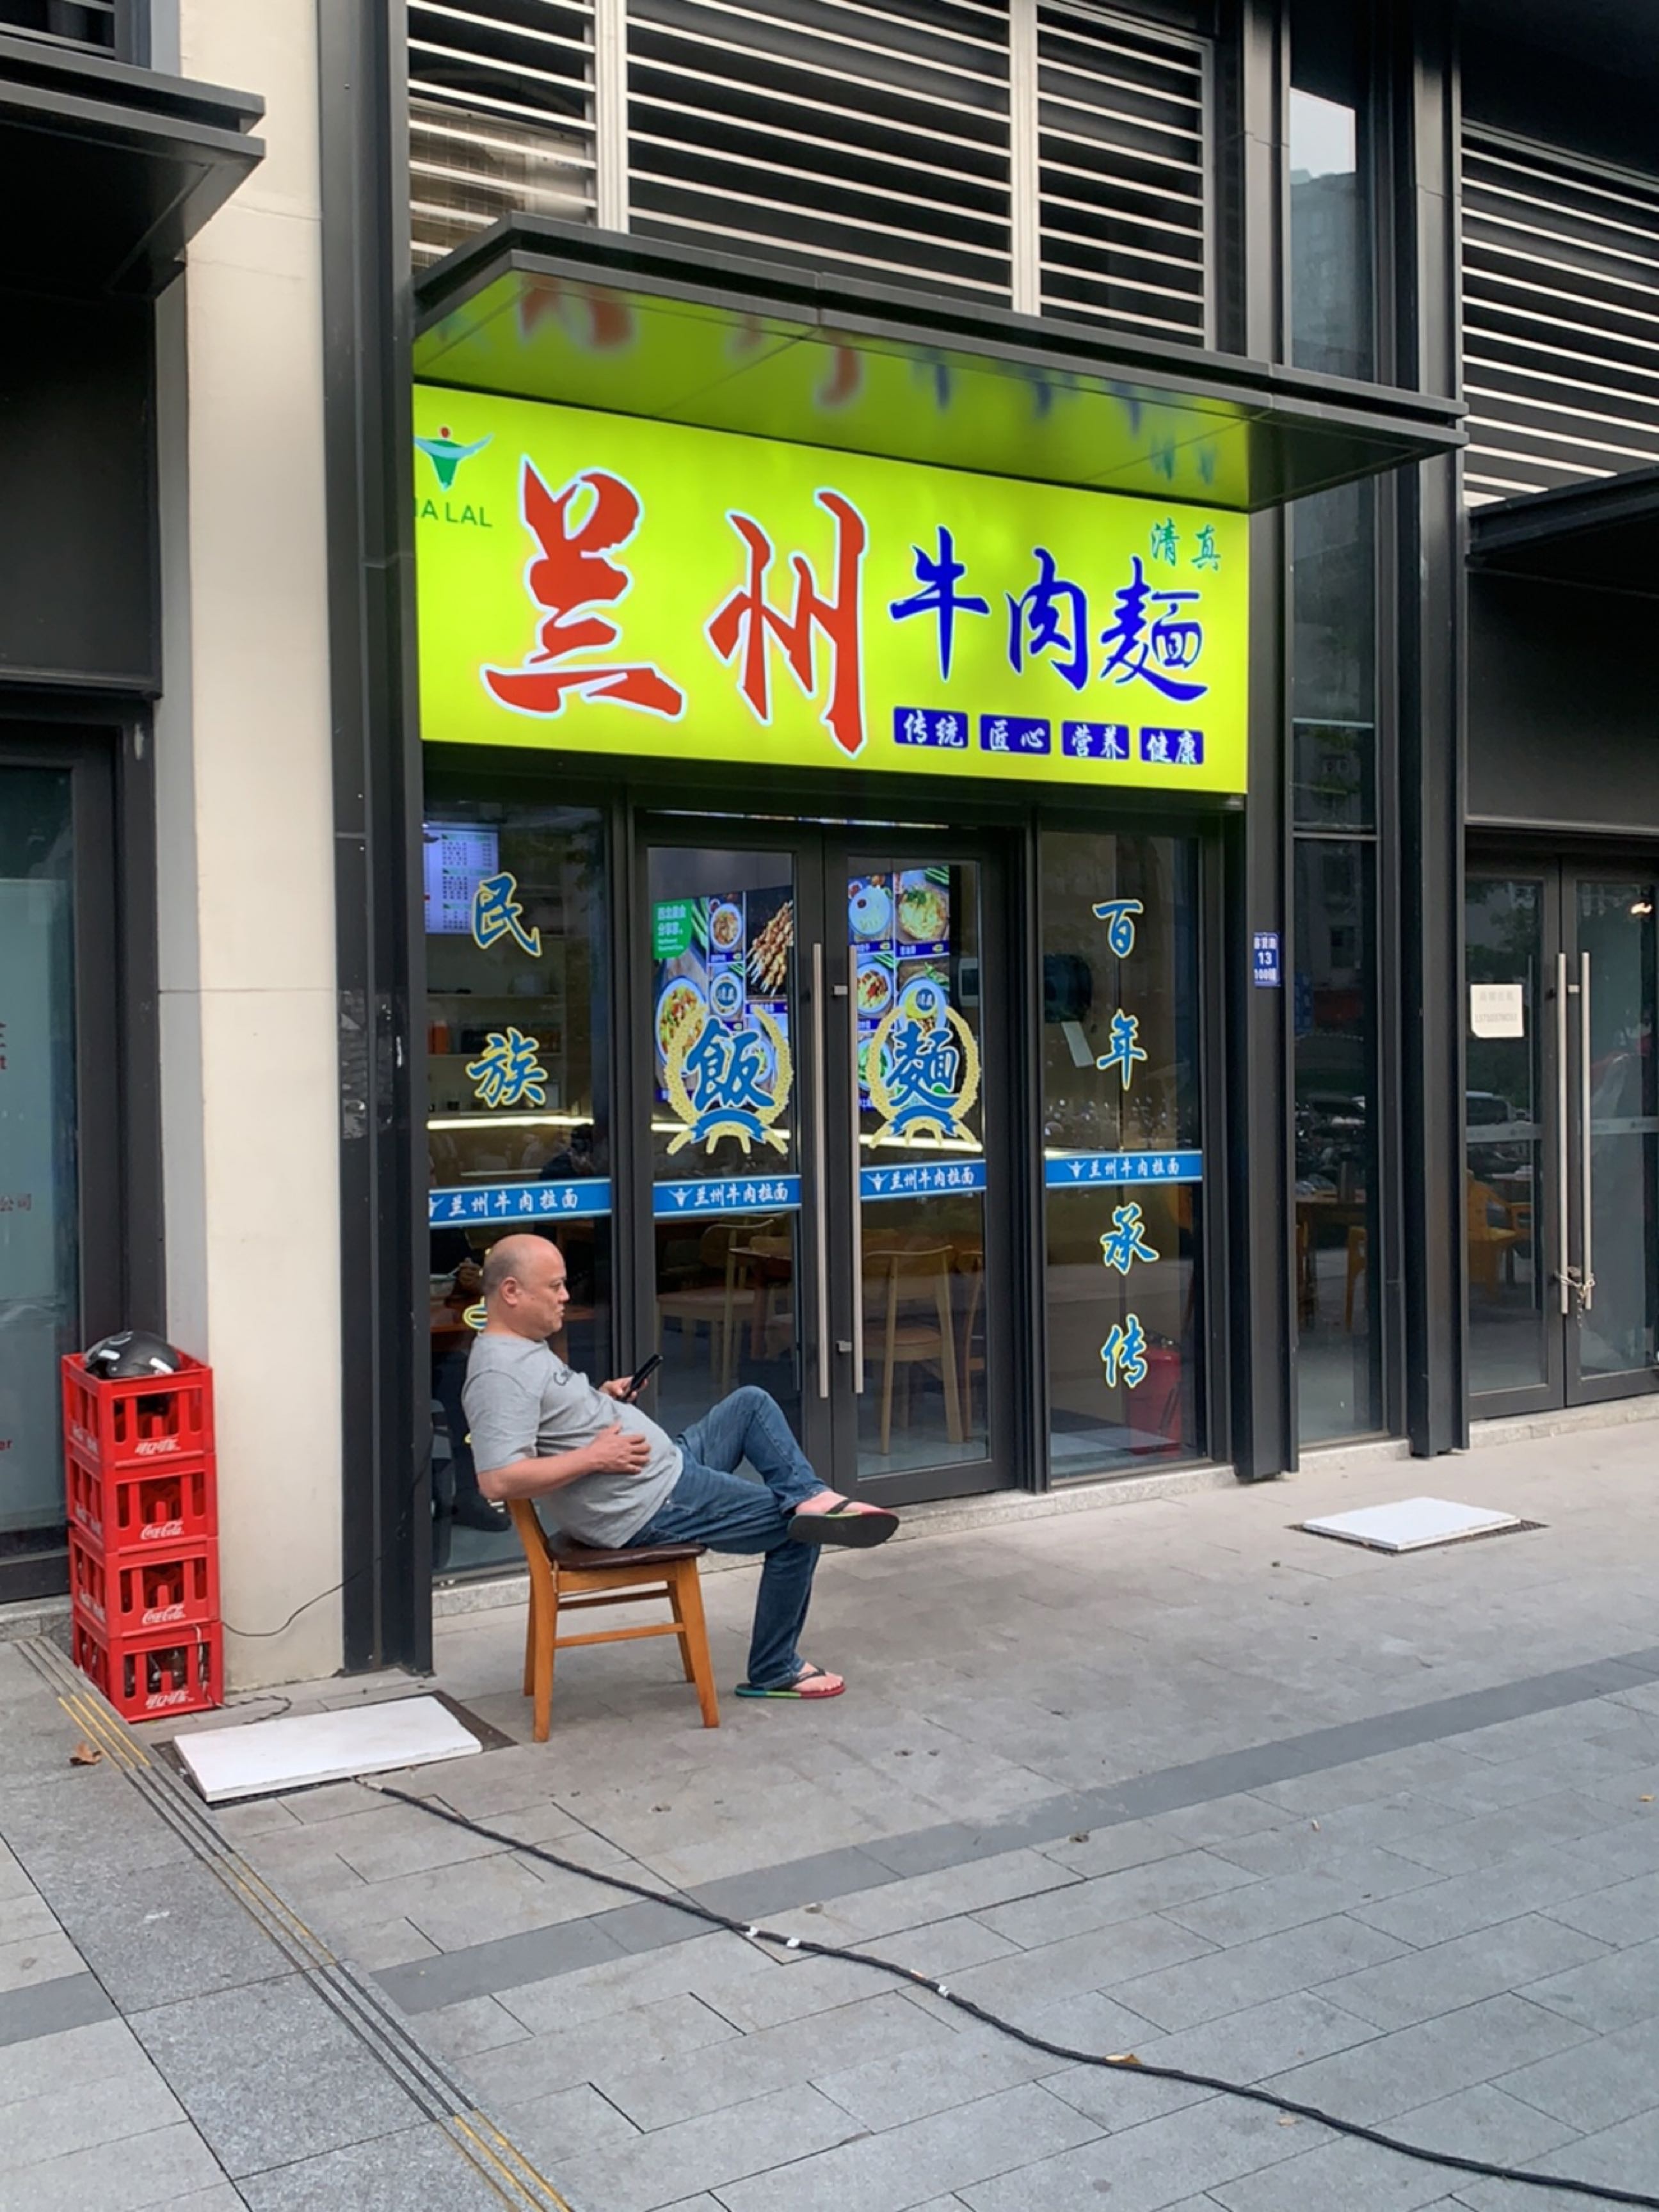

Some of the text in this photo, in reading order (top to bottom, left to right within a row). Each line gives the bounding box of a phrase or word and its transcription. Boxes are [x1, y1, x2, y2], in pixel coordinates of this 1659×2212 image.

[1151, 517, 1221, 572] 清真
[903, 709, 1198, 764] 传统 匠心 营养 健康
[1258, 951, 1272, 965] 13
[890, 1166, 974, 1191] 兰州牛肉拉面
[1089, 1157, 1180, 1180] 兰州牛肉拉面
[448, 1187, 579, 1217] 兰州牛肉拉面
[694, 1182, 789, 1207] 兰州牛肉拉面
